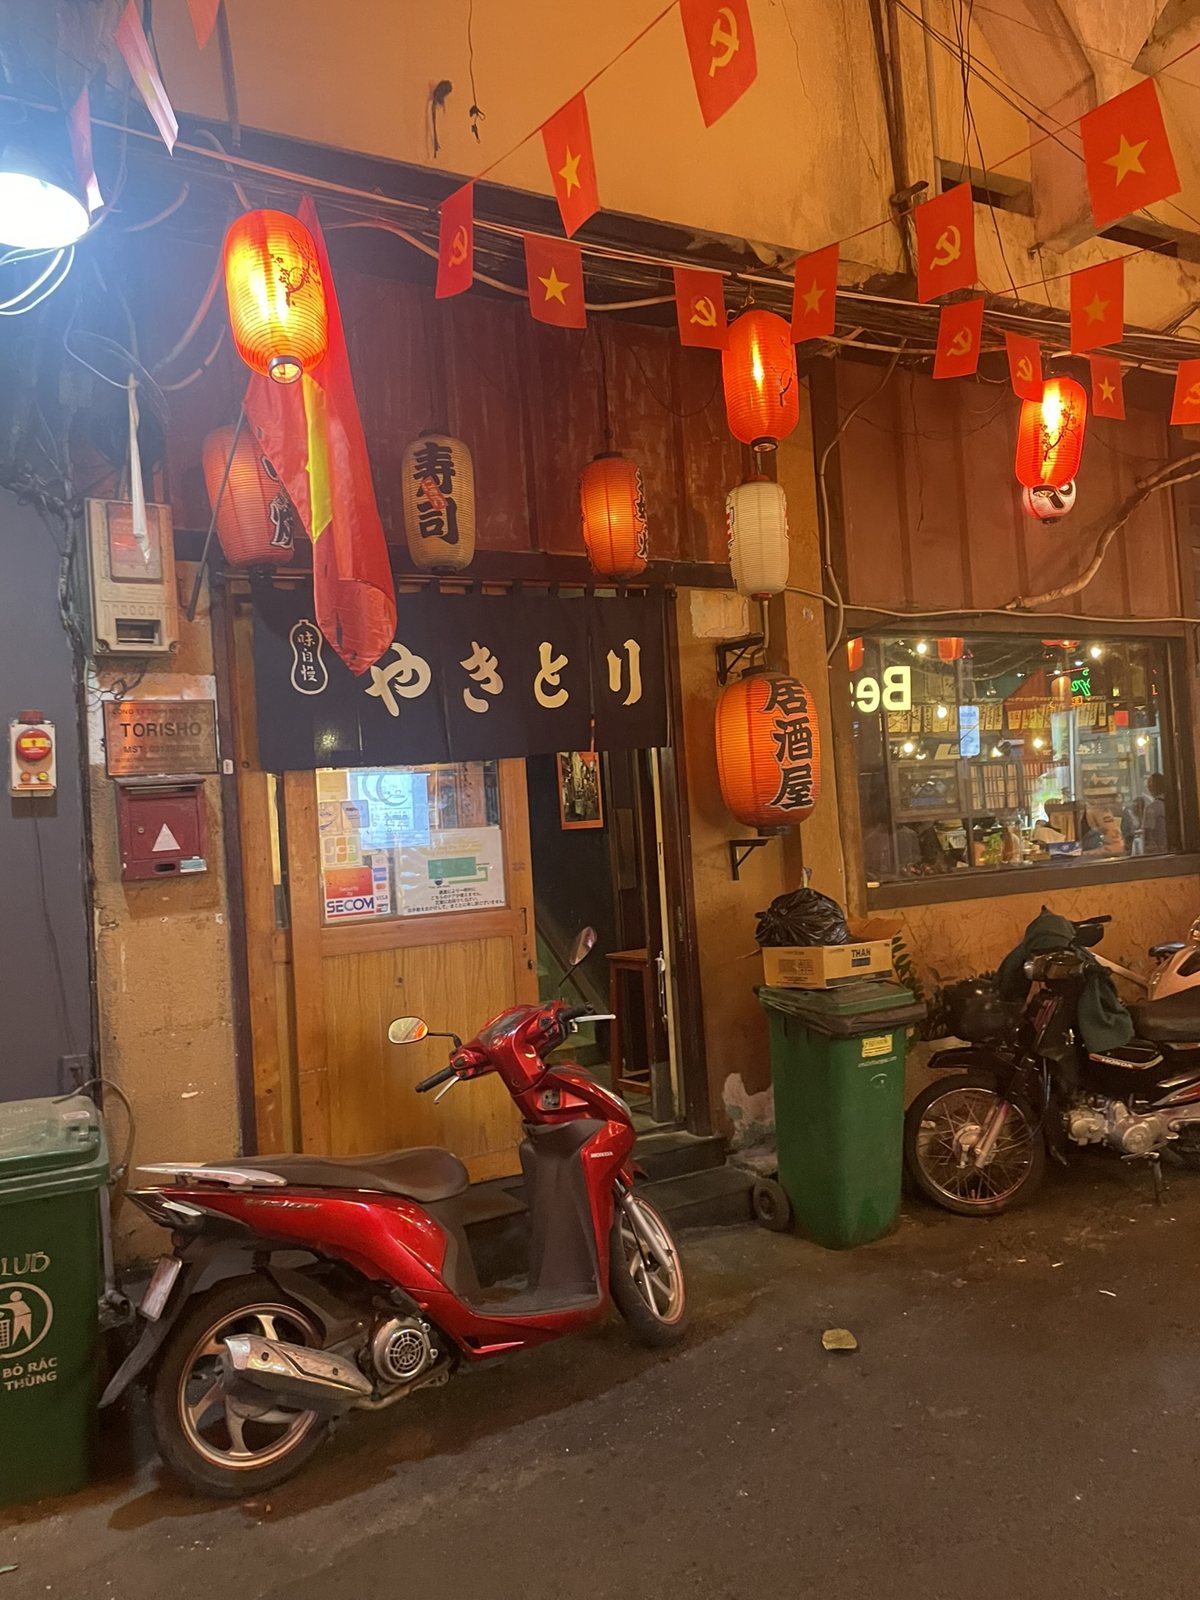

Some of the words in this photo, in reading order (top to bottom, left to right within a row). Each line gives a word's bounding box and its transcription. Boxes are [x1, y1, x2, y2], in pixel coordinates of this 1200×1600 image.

[413, 442, 460, 545] 寿司
[364, 638, 642, 718] やきとり
[120, 722, 202, 737] TORISHO
[762, 678, 814, 812] 居酒屋
[324, 844, 357, 856] JCB
[327, 897, 375, 914] SECOM
[28, 1357, 58, 1373] RÁC
[4, 1371, 58, 1391] THÙNG
